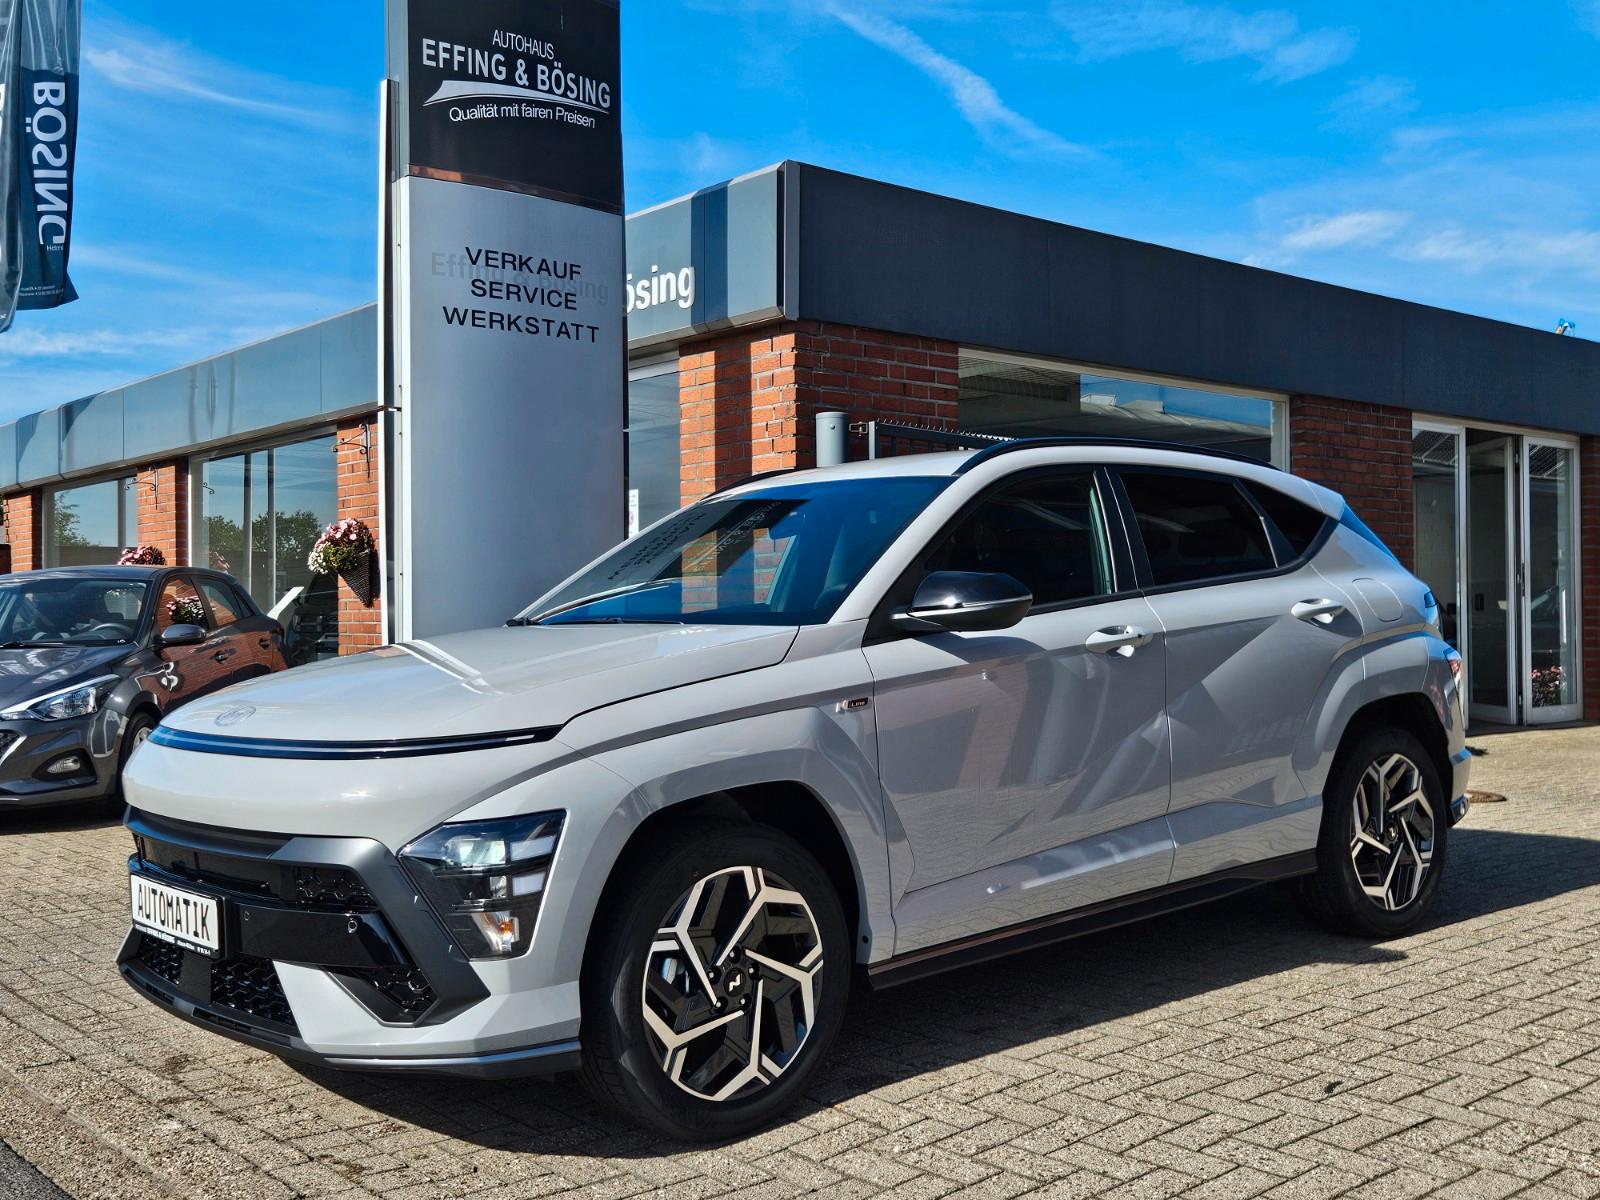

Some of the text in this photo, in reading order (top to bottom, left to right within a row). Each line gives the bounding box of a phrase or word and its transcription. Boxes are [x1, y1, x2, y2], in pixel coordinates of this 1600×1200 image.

[492, 29, 555, 60] AUTOHAUS
[421, 38, 611, 109] EFFING & BÖSING
[449, 103, 596, 129] Qualität mit fairen Preisen
[465, 247, 582, 281] VERKAUF
[470, 279, 577, 311] SERVICE
[442, 306, 600, 343] WERKSTATT
[138, 883, 211, 942] AUTOMATIK
